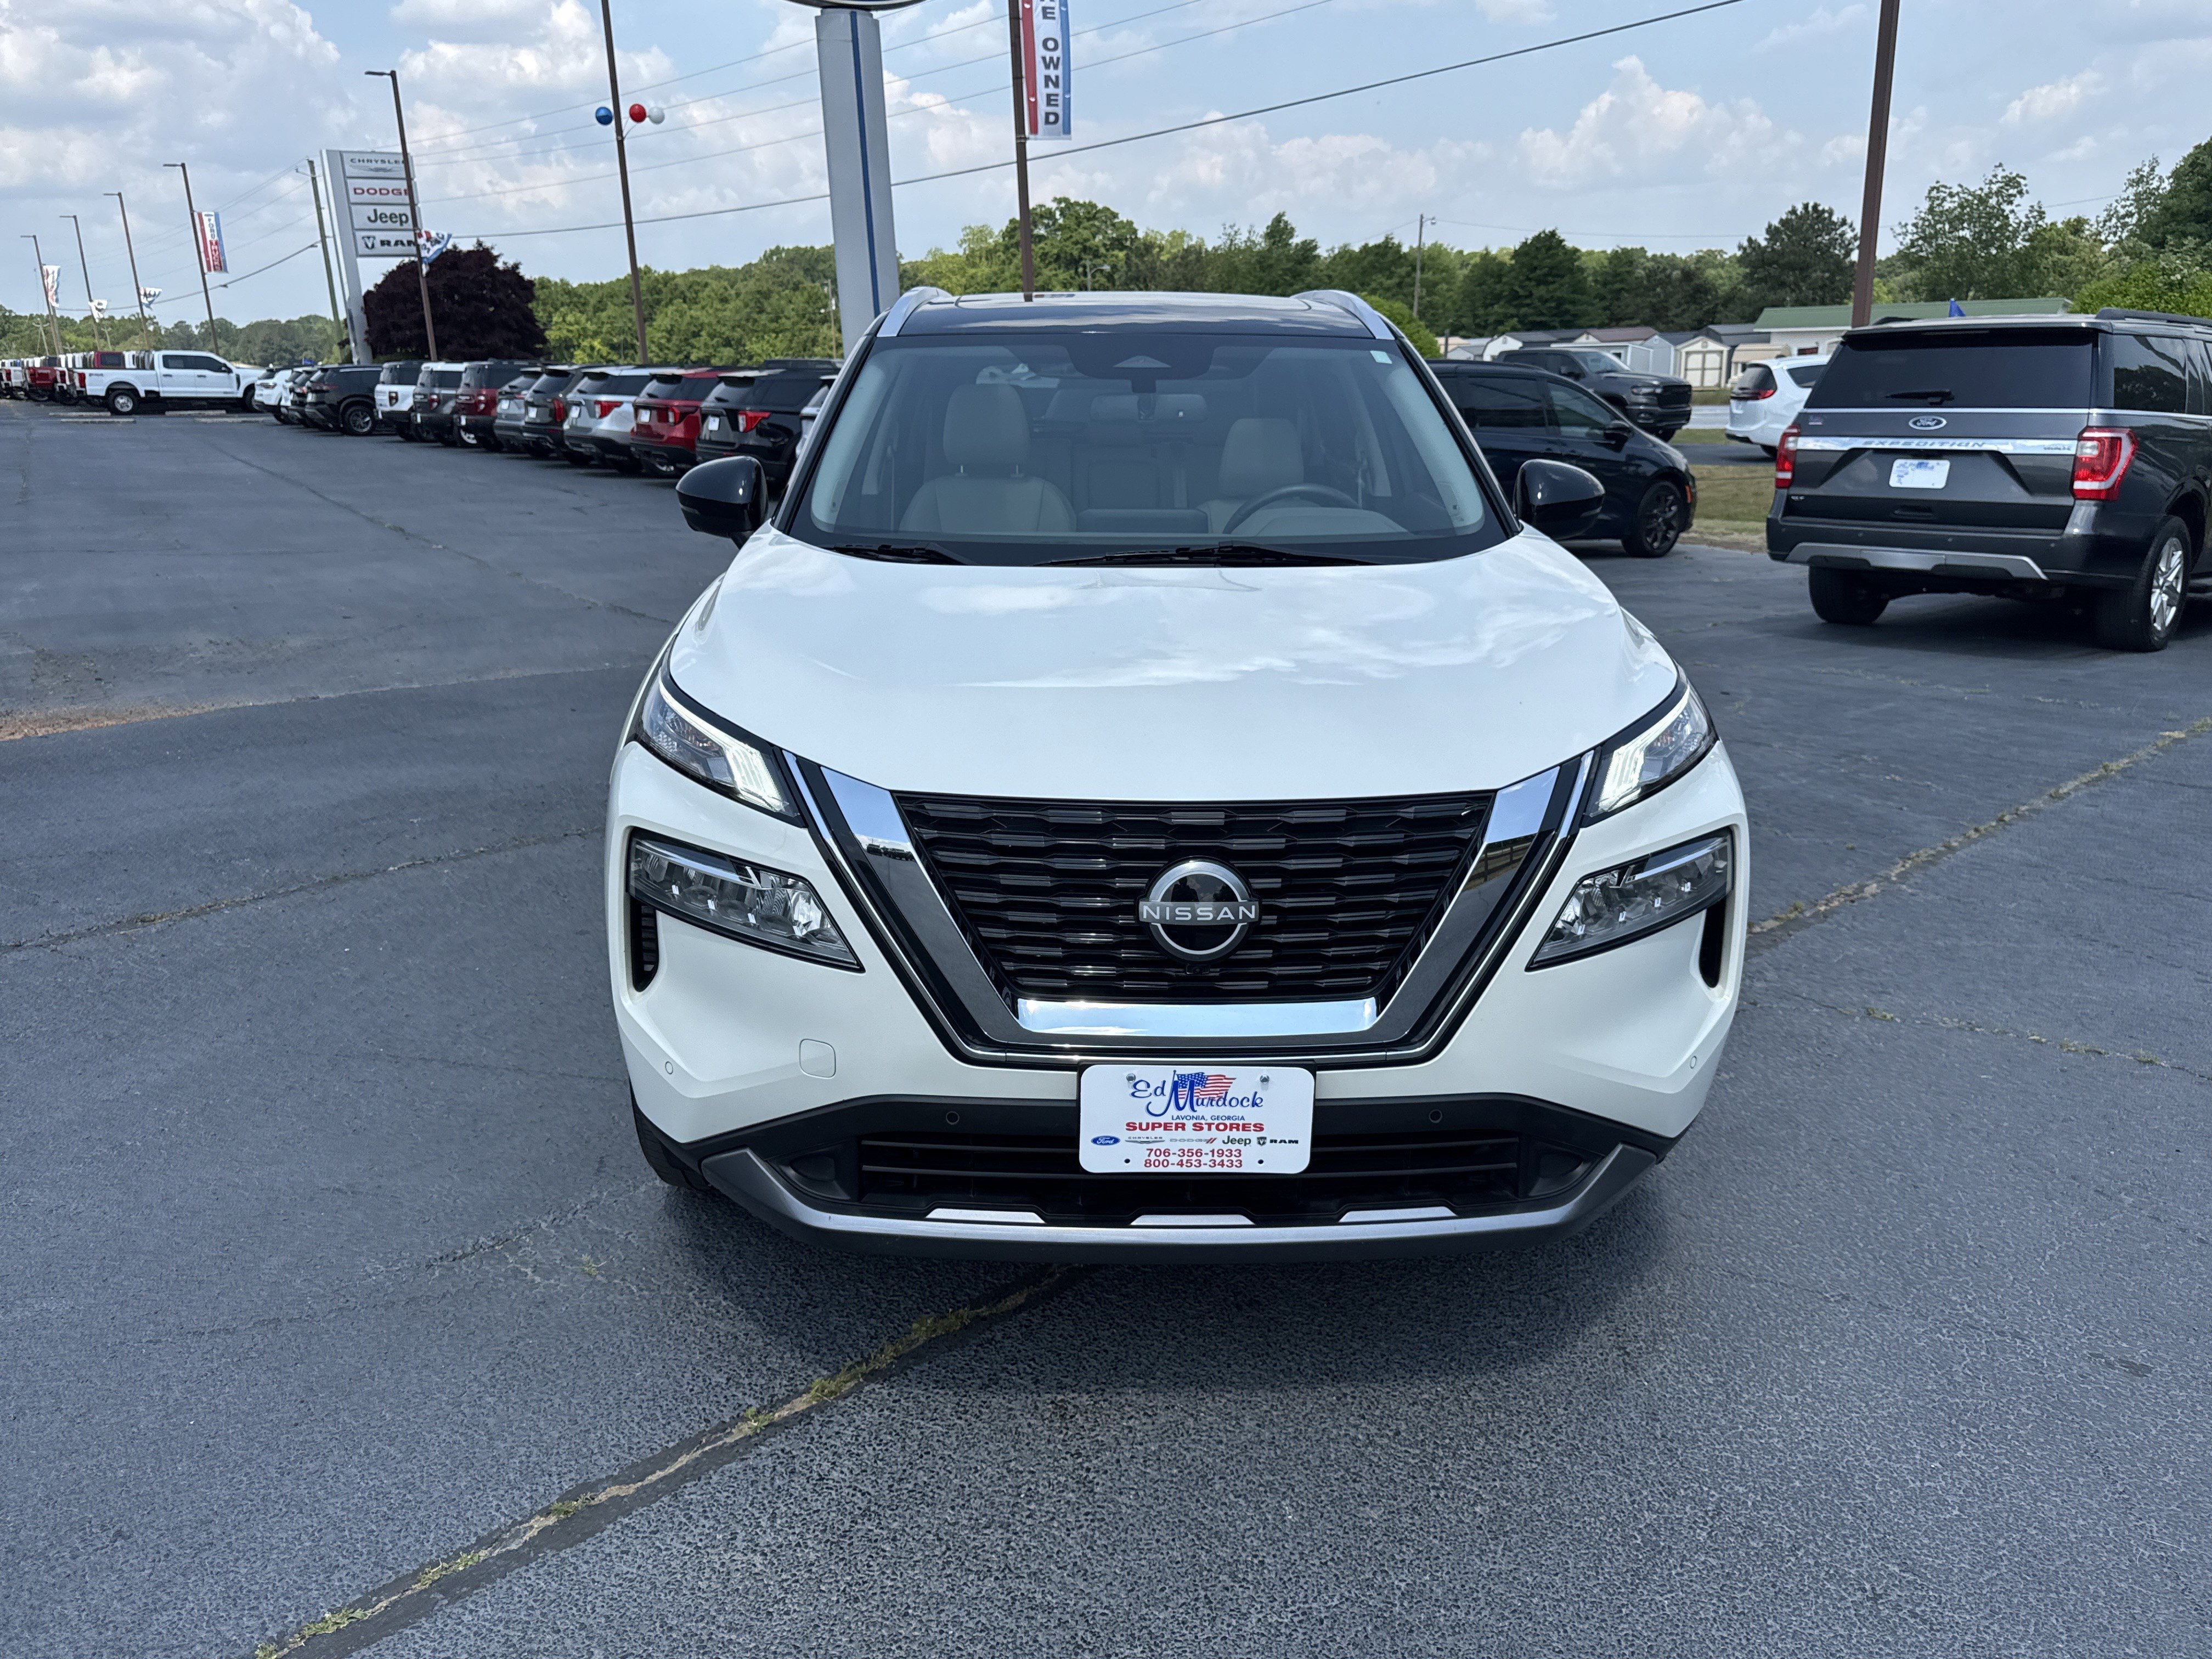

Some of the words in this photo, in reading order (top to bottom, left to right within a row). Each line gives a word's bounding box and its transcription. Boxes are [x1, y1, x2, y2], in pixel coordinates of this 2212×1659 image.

[1041, 0, 1056, 20] E
[1041, 37, 1060, 126] OWNED
[367, 208, 409, 226] Jeep
[1143, 905, 1255, 921] NISSAN
[1130, 1079, 1166, 1098] Ed
[1146, 1079, 1263, 1117] Murdock
[1125, 1121, 1186, 1131] SUPER
[1192, 1122, 1265, 1132] STORES
[1222, 1135, 1252, 1147] Jeep
[1146, 1148, 1242, 1158] 706-356-1933
[1144, 1158, 1243, 1167] 800-453-3433
